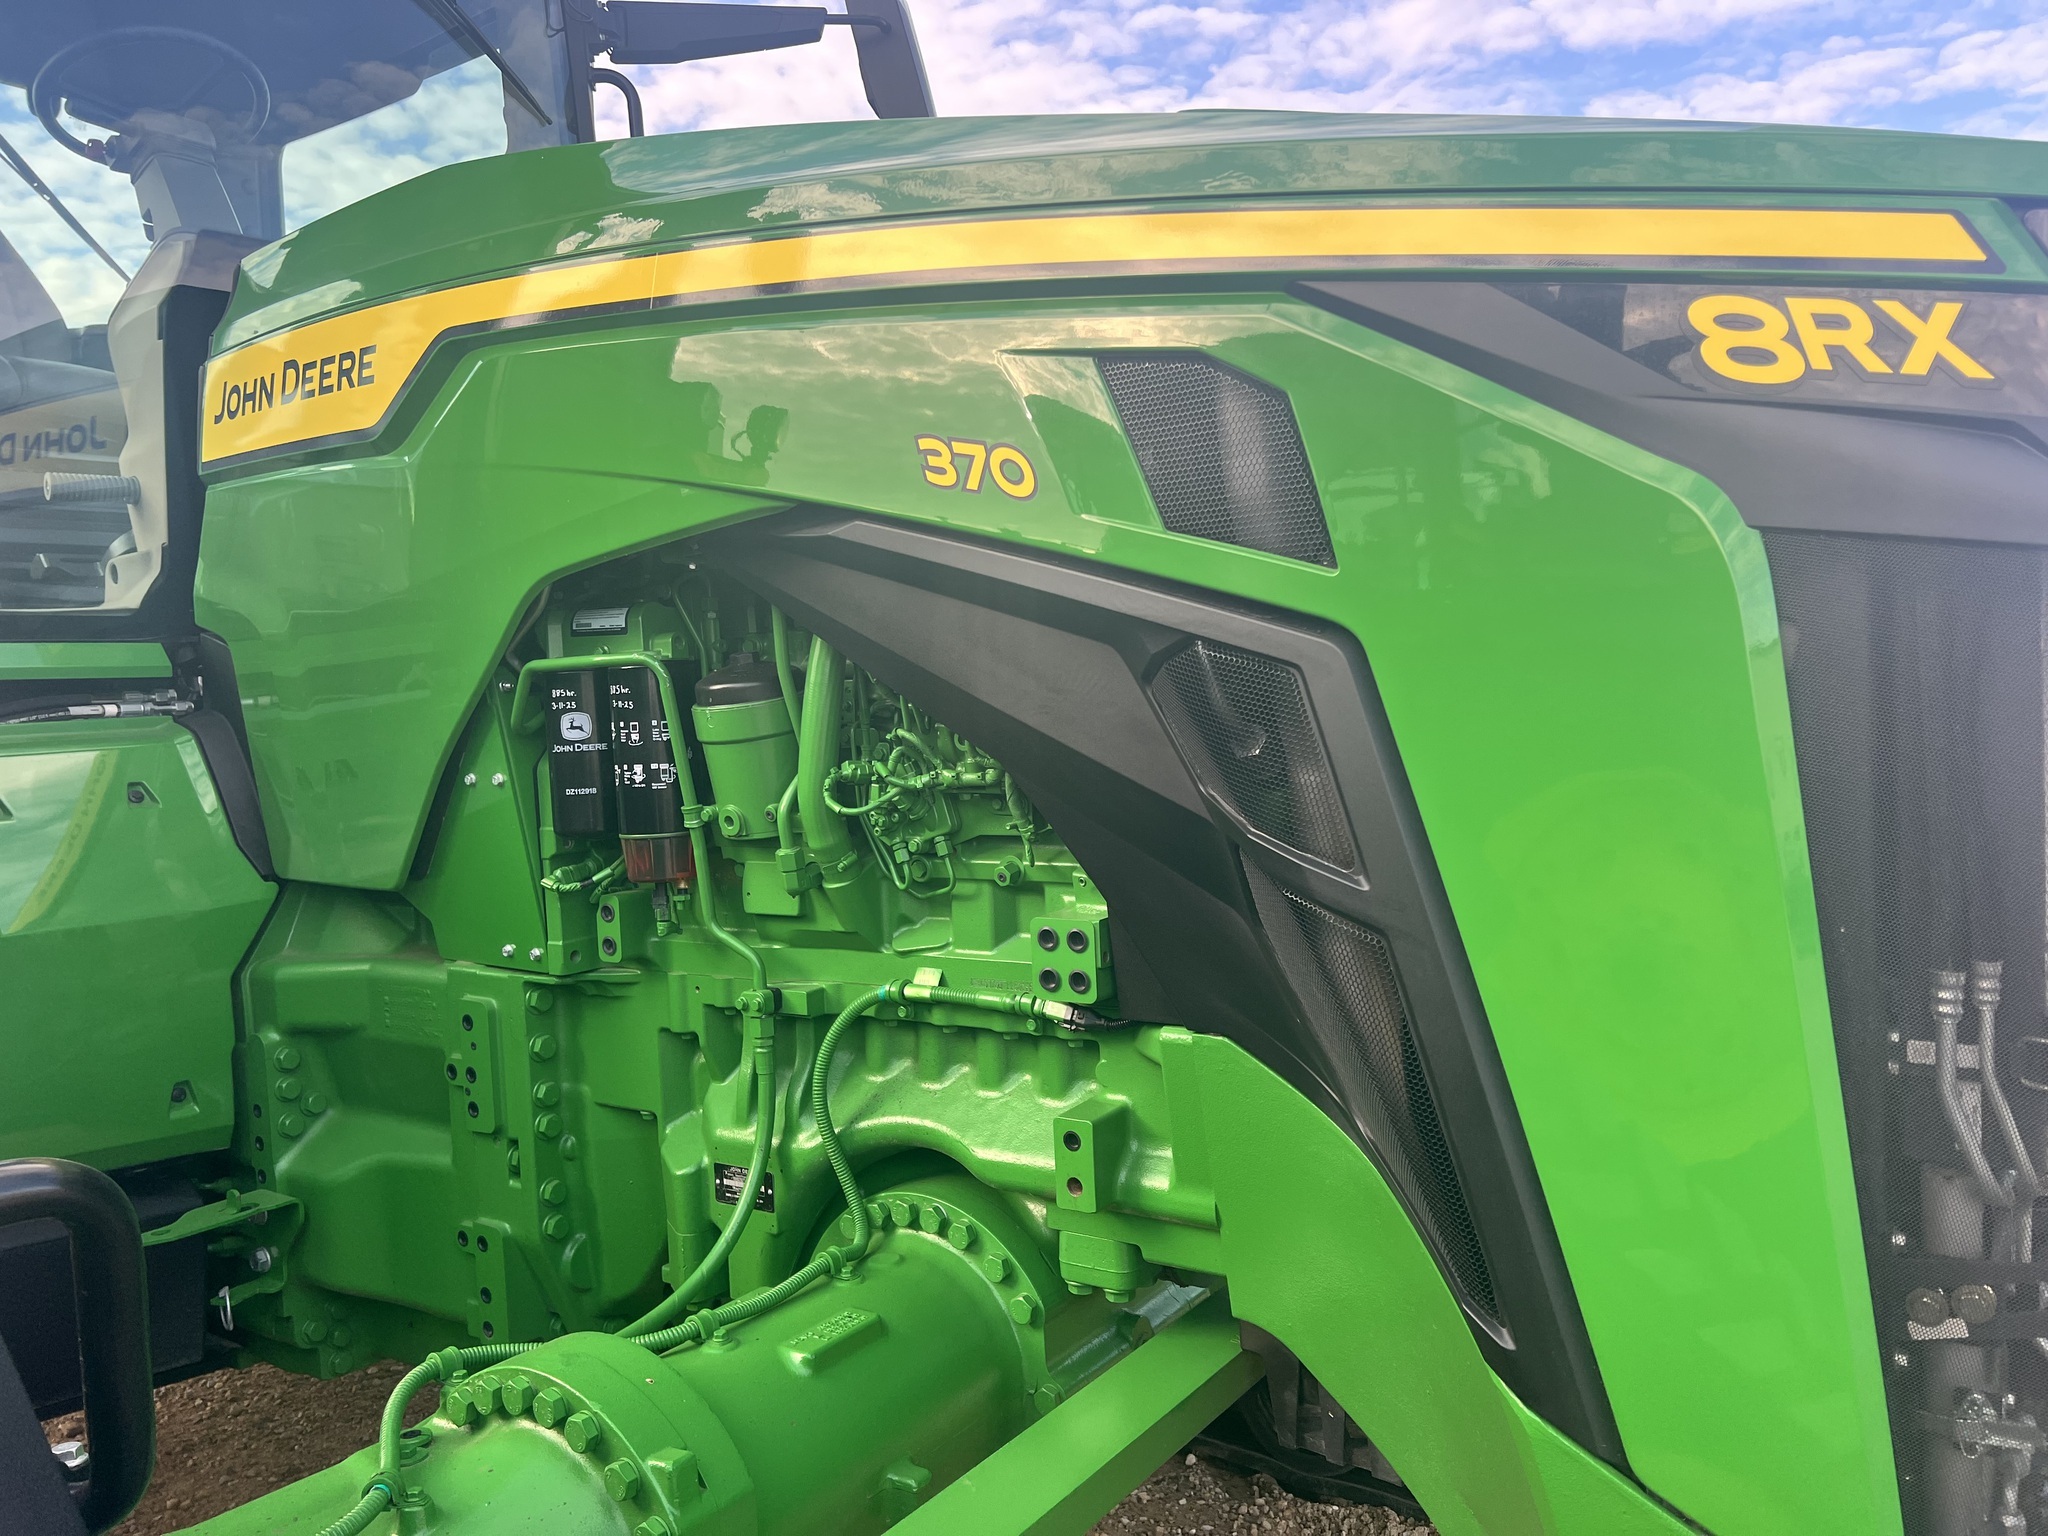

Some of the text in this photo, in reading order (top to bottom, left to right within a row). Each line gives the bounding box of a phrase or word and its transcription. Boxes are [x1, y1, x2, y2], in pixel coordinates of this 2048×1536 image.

[1687, 294, 1995, 384] 8RX
[214, 344, 377, 425] JOHN DEERE
[916, 435, 1037, 500] 370
[552, 742, 608, 753] JOHN DEERE
